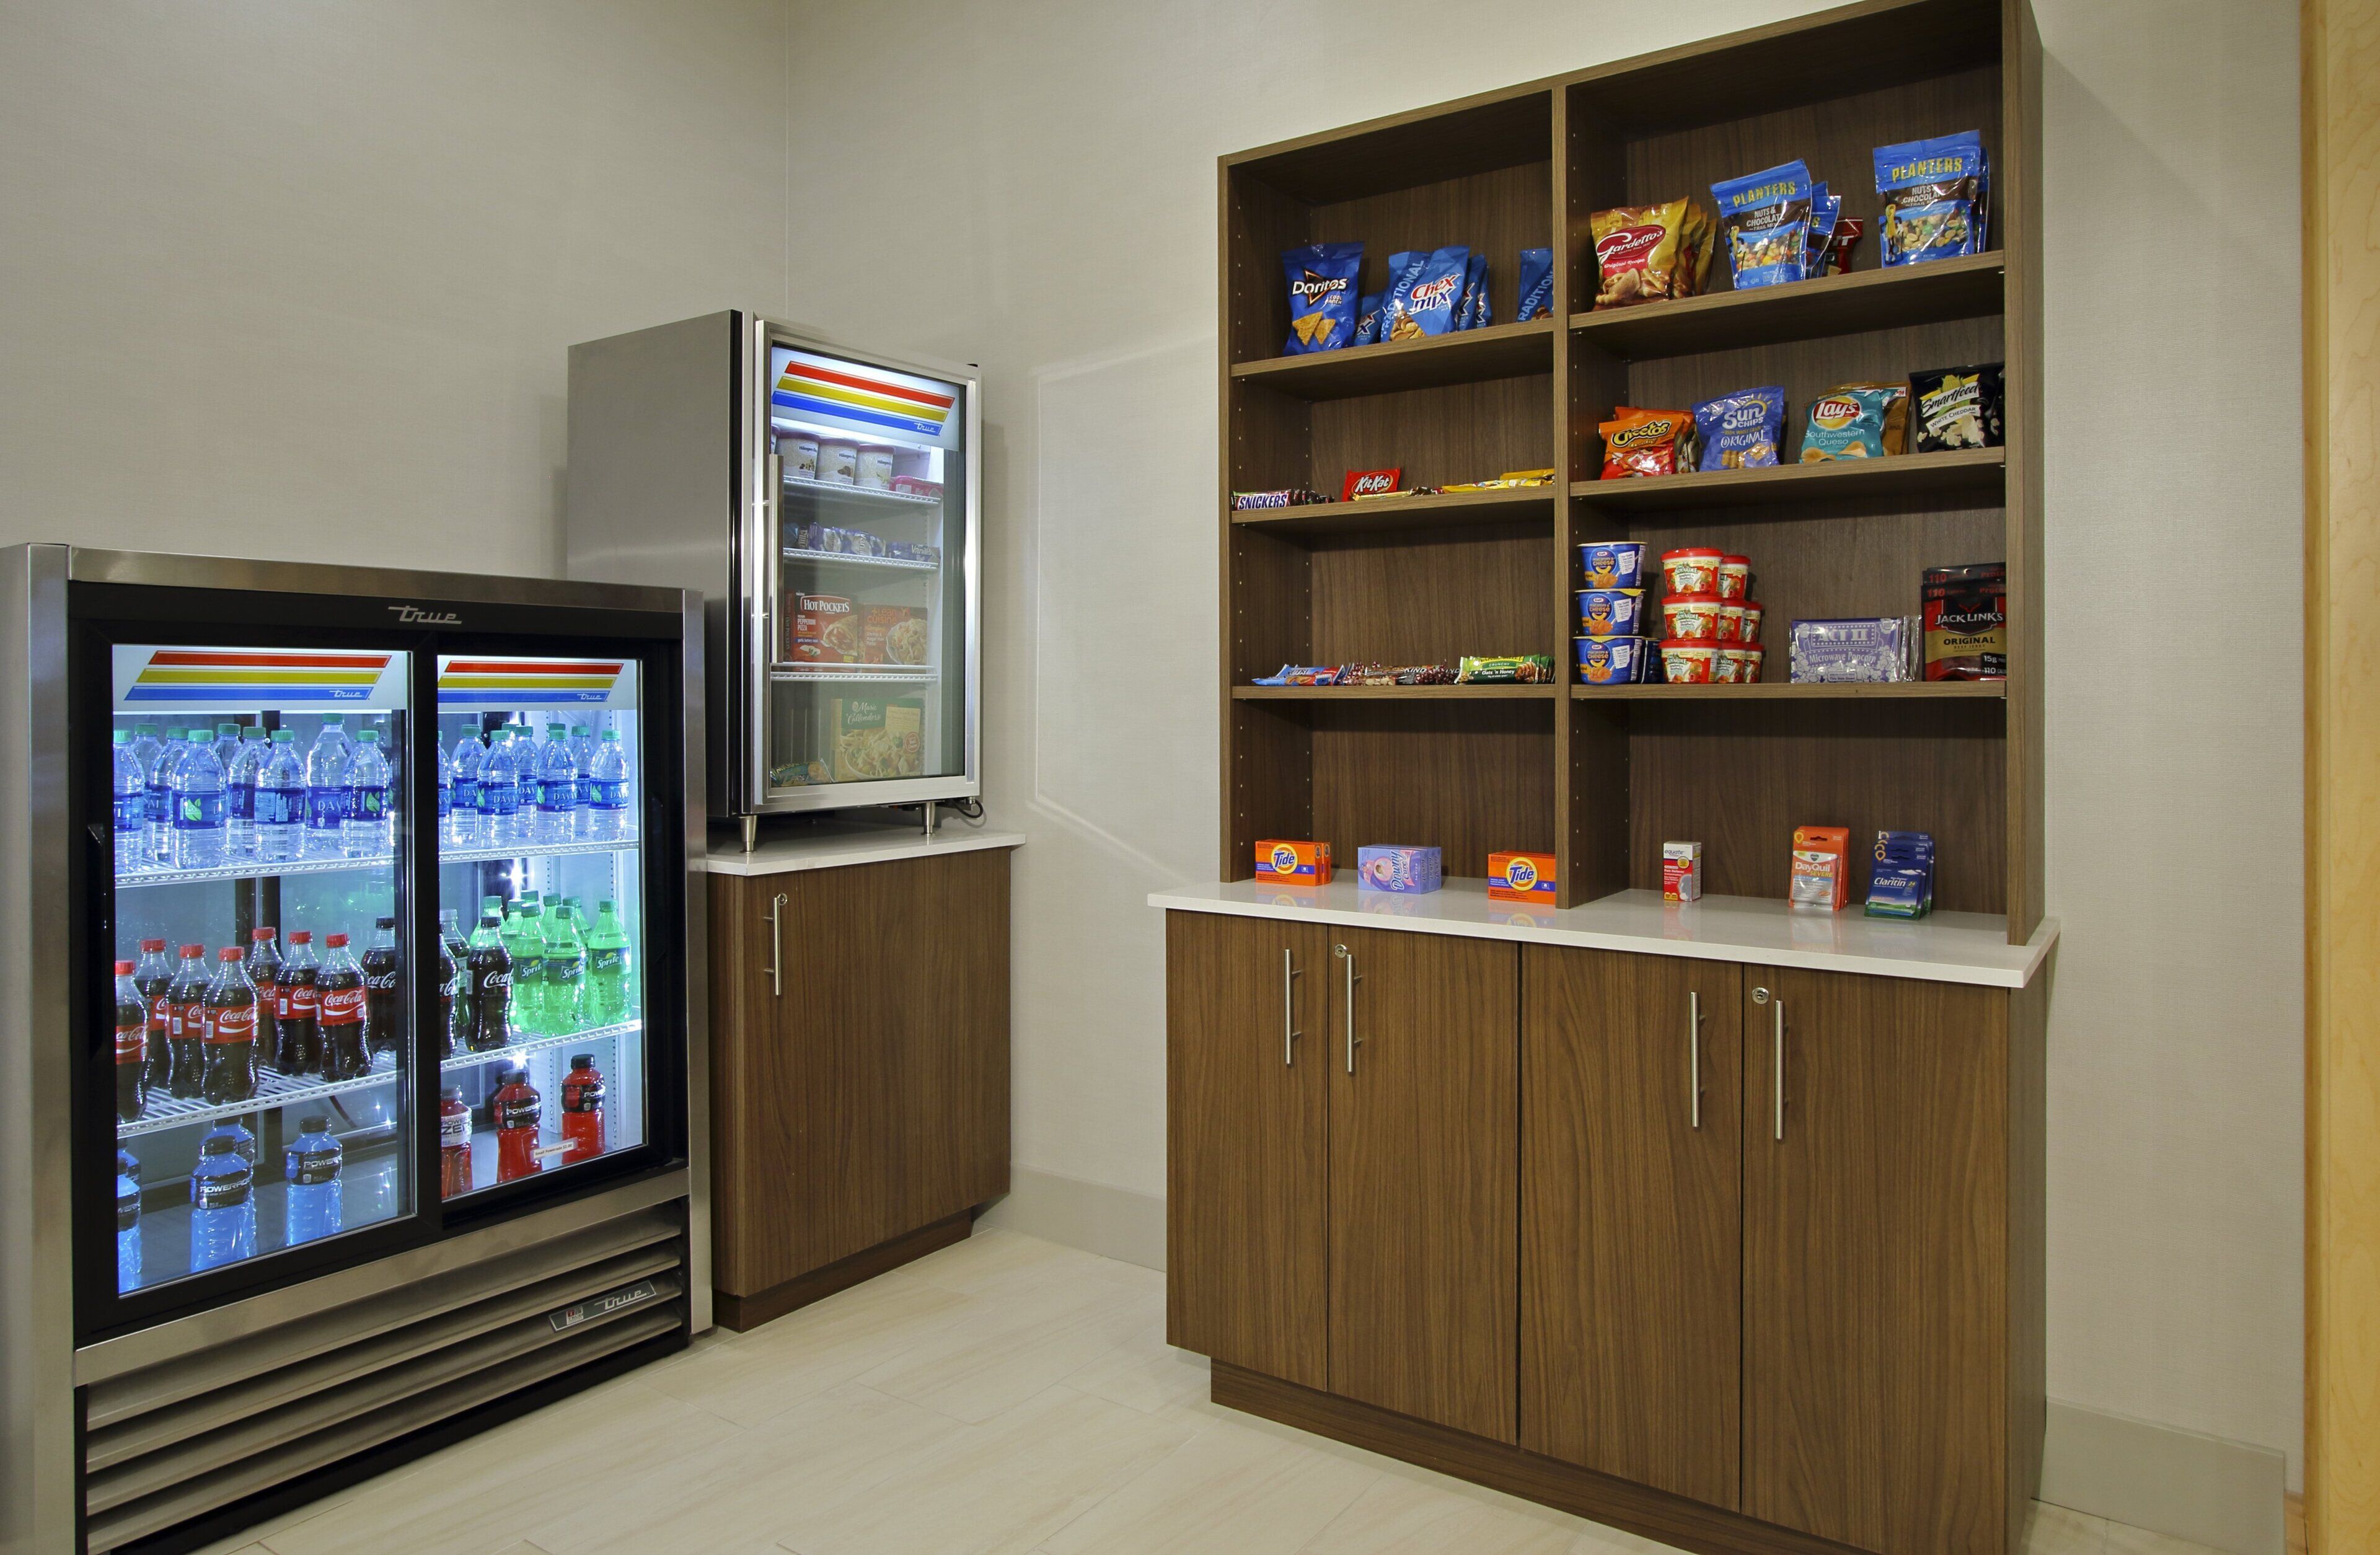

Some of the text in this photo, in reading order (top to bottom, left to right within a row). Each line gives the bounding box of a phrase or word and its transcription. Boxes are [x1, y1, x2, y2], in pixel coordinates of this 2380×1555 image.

[1892, 157, 1963, 183] PLANTERS
[1732, 181, 1796, 207] PLANTERS
[1912, 185, 1931, 195] NUTS
[1754, 208, 1770, 218] NUTS
[1596, 232, 1664, 265] Gardetto's
[1604, 258, 1646, 269] Original Recipe
[1292, 278, 1349, 295] Doritos
[1411, 274, 1461, 300] Chex
[1921, 382, 1980, 415] Smartfood
[1722, 406, 1765, 429] Sun
[1816, 401, 1858, 420] Lay's
[1930, 407, 1977, 428] WHITE CHEDDAR
[1737, 416, 1764, 428] CHIPS
[1612, 421, 1670, 446] Cheetos
[1721, 429, 1768, 448] ORIGINAL
[1805, 429, 1865, 438] Southwestern
[1818, 438, 1848, 446] Queso
[1238, 494, 1287, 509] SNICKERS
[1929, 573, 1947, 584] 110
[1927, 588, 1946, 597] 110
[804, 599, 850, 613] HOT POCKETS
[1935, 614, 1965, 625] JACK
[1818, 628, 1869, 642] ACT II
[1943, 636, 1996, 645] ORIGINAL
[1809, 651, 1877, 664] Microwave Popcorn
[1984, 655, 1998, 663] 15g
[1274, 851, 1295, 868] Tide
[1391, 850, 1405, 891] Downy
[1795, 861, 1830, 873] DayQuil
[1509, 866, 1535, 884] Tide
[1874, 877, 1906, 887] Claritin
[522, 963, 542, 977] Sprit
[325, 989, 363, 1007] Coca-Cola
